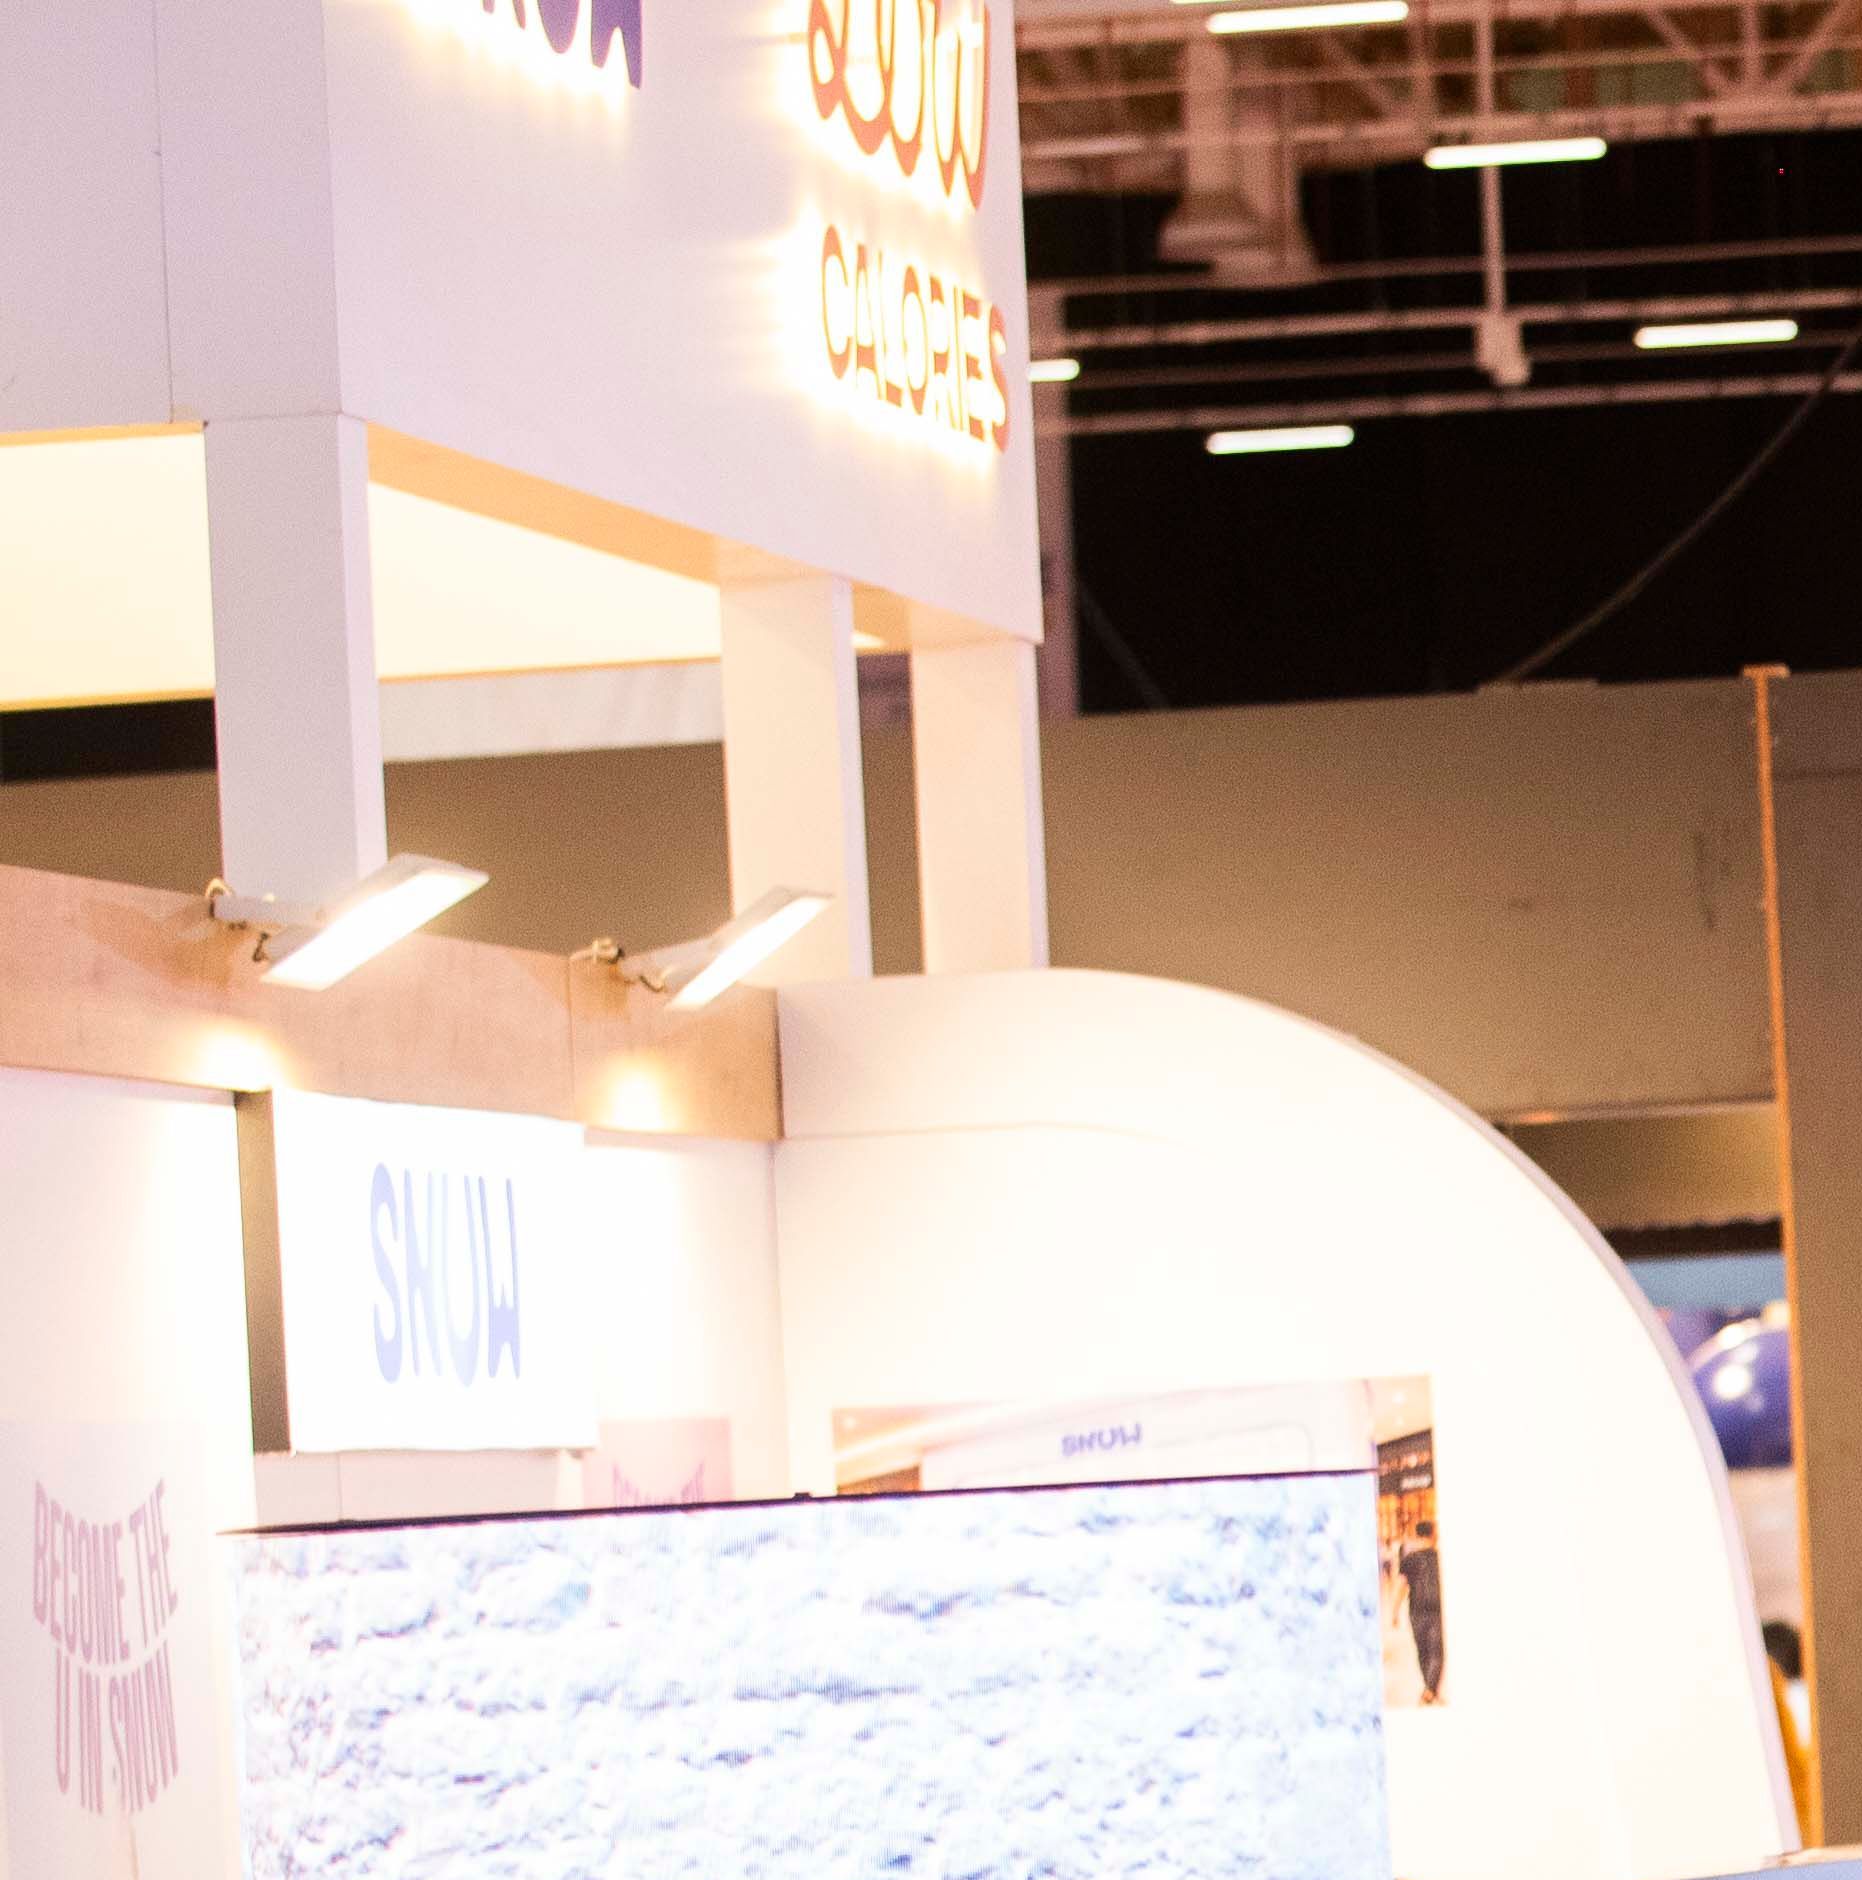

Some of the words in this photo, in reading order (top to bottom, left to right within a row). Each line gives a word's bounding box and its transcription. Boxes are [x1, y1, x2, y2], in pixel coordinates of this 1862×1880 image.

[822, 223, 1010, 455] CALORIES
[33, 1479, 130, 1666] BECOME
[129, 1478, 178, 1648] THE
